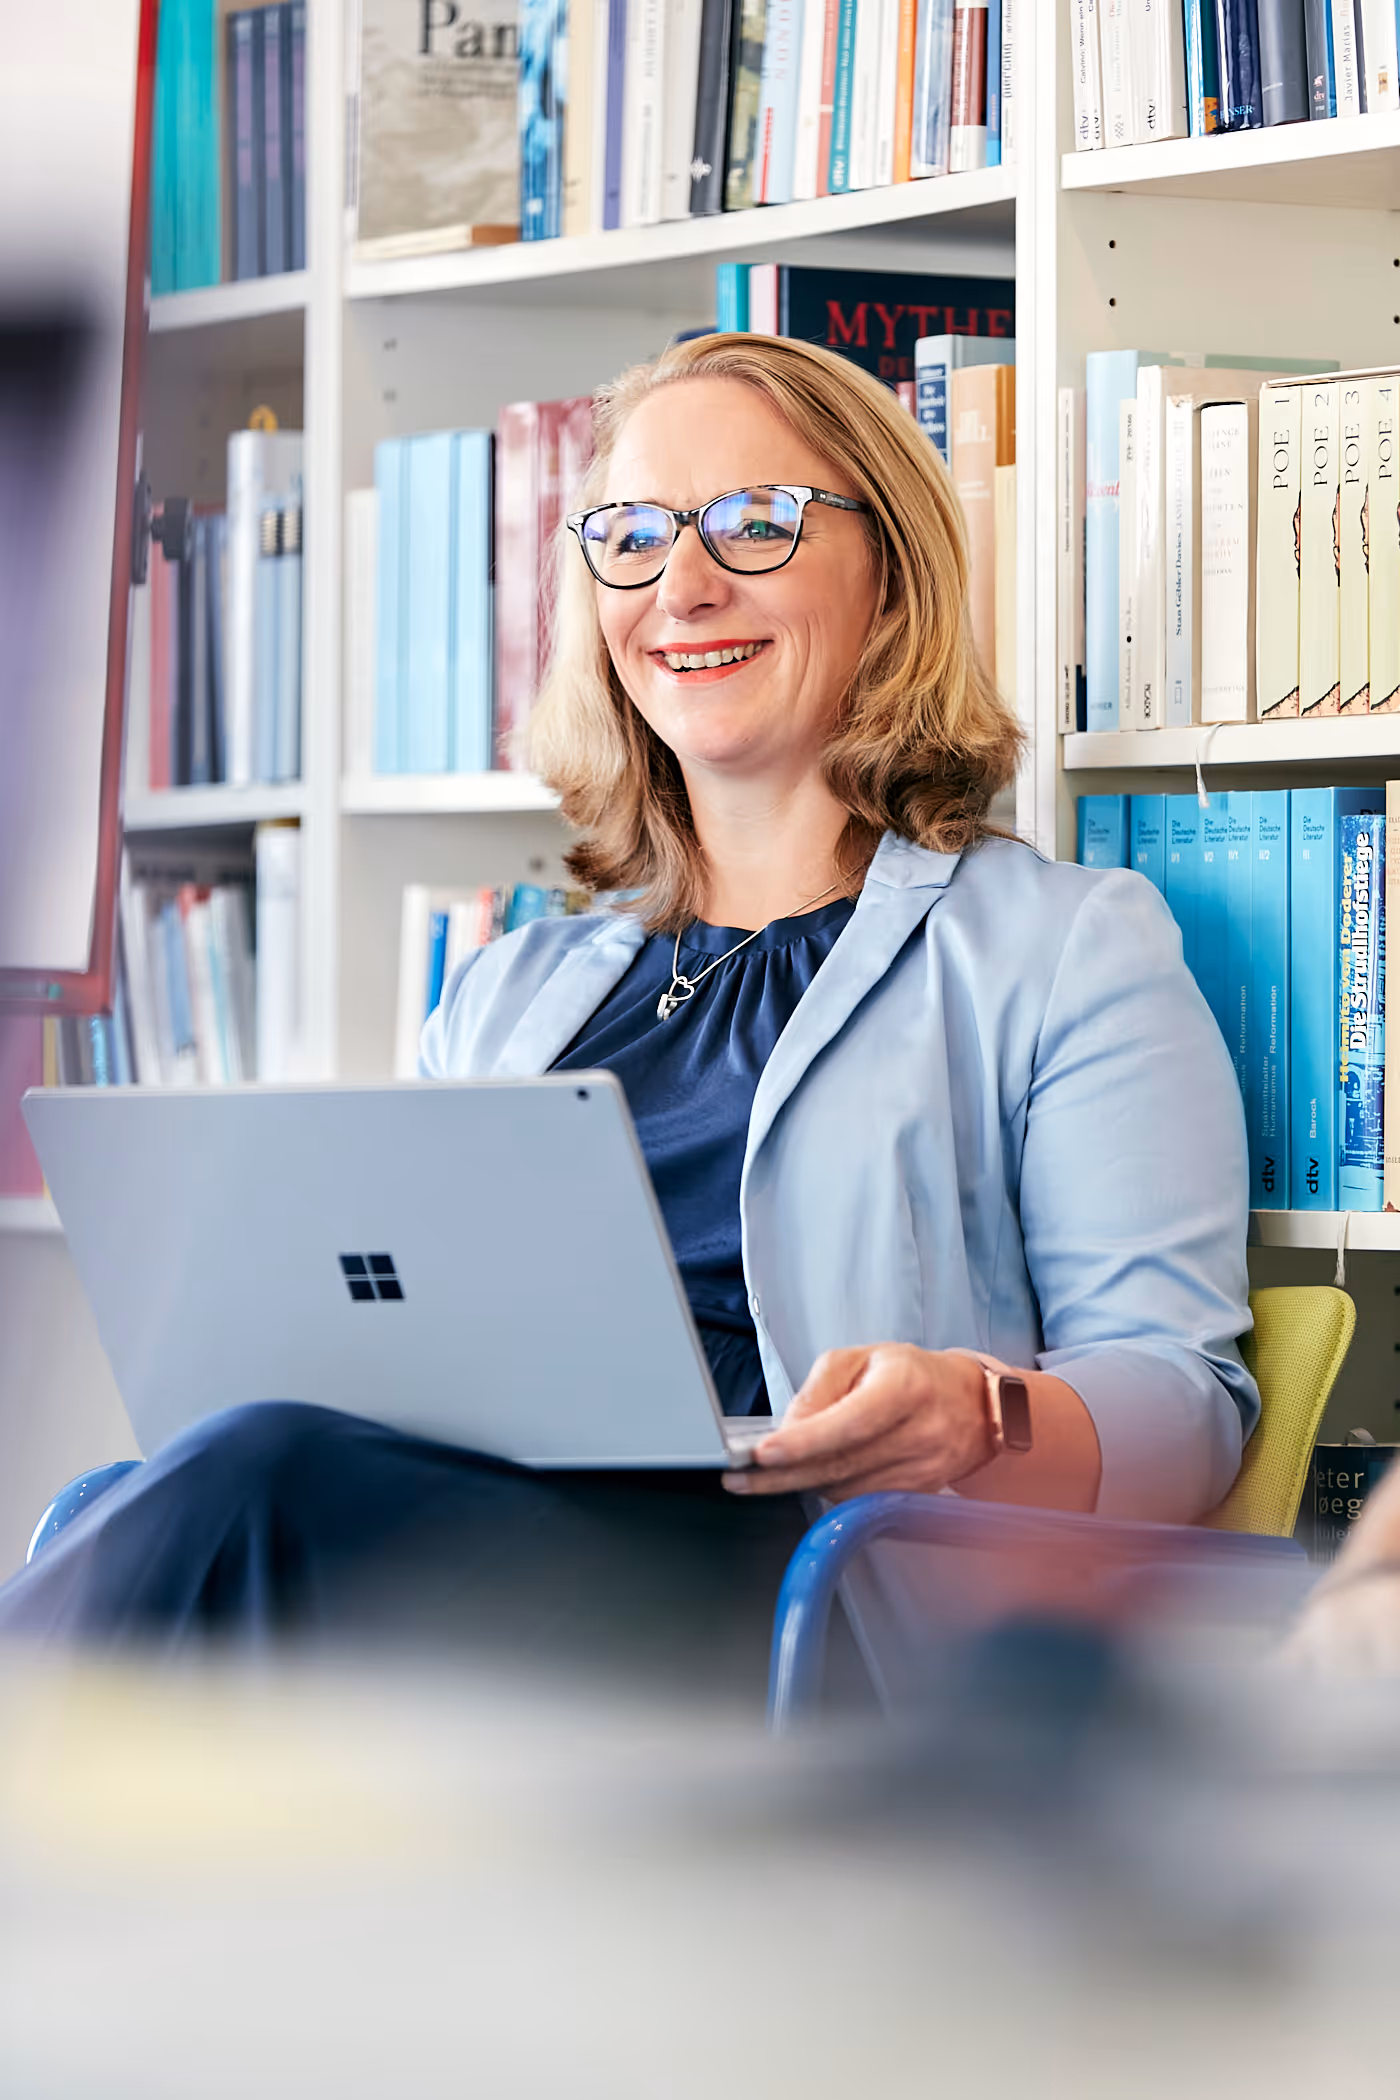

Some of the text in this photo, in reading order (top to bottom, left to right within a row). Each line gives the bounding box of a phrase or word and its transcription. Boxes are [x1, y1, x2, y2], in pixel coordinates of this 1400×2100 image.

[1344, 67, 1353, 101] Javier
[1079, 115, 1089, 140] dtv
[1146, 104, 1156, 130] dtv
[1313, 392, 1329, 487] POE 2
[1344, 390, 1360, 484] POE 3
[1378, 388, 1392, 480] POE 4
[1273, 430, 1289, 490] POE
[1144, 683, 1152, 720] PICADOR
[1302, 815, 1312, 823] Die
[1302, 824, 1326, 832] Deutsche
[1351, 831, 1374, 1010] Strudlhofstiege
[1339, 852, 1353, 1083] Heimito von Doderer
[1269, 985, 1277, 1054] Reformation
[1350, 1010, 1368, 1050] Die
[1309, 1097, 1318, 1139] Barock
[1261, 1156, 1275, 1193] dtv
[1306, 1157, 1320, 1194] dtv
[1316, 1467, 1365, 1489] eter
[1319, 1496, 1364, 1520] øeg
